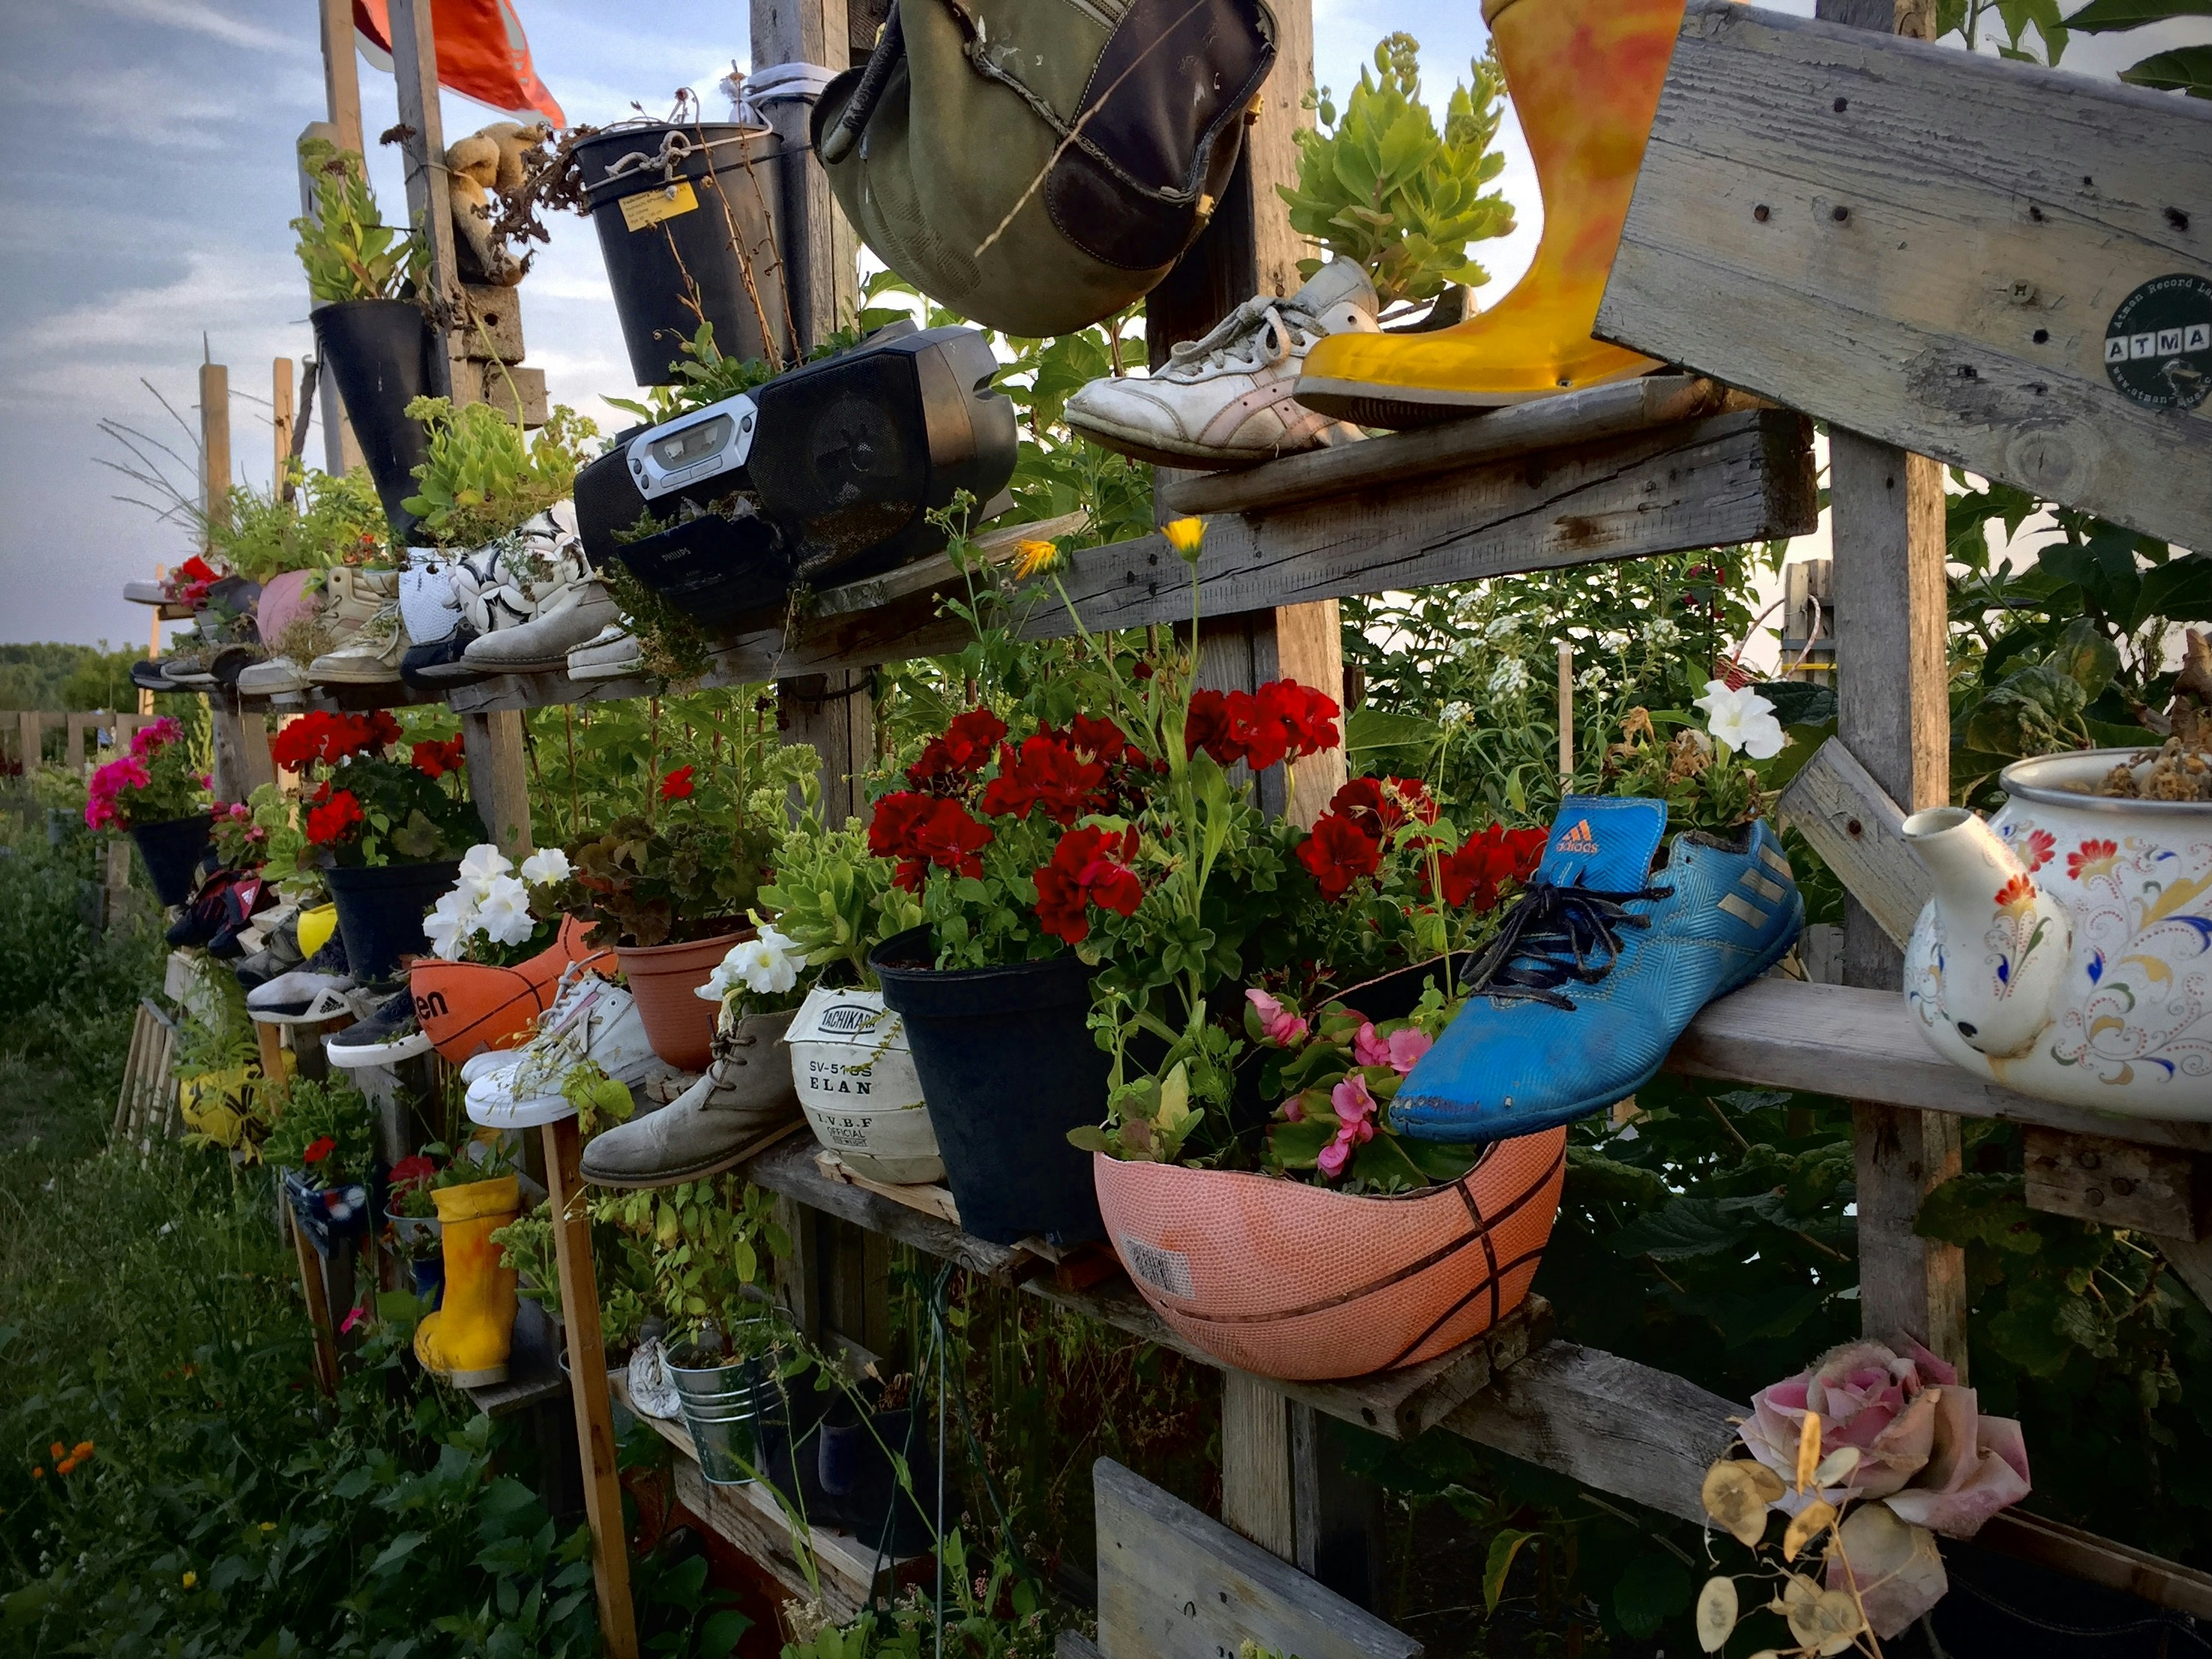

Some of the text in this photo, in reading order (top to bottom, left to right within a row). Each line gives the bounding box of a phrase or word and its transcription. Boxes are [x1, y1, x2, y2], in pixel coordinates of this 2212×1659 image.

[2114, 279, 2212, 329] Atman Record La
[661, 547, 691, 562] PHILIPS
[1556, 840, 1600, 854] adidas
[414, 991, 449, 1020] en
[810, 1076, 872, 1094] ELAN
[827, 1126, 865, 1138] OFFICIAL
